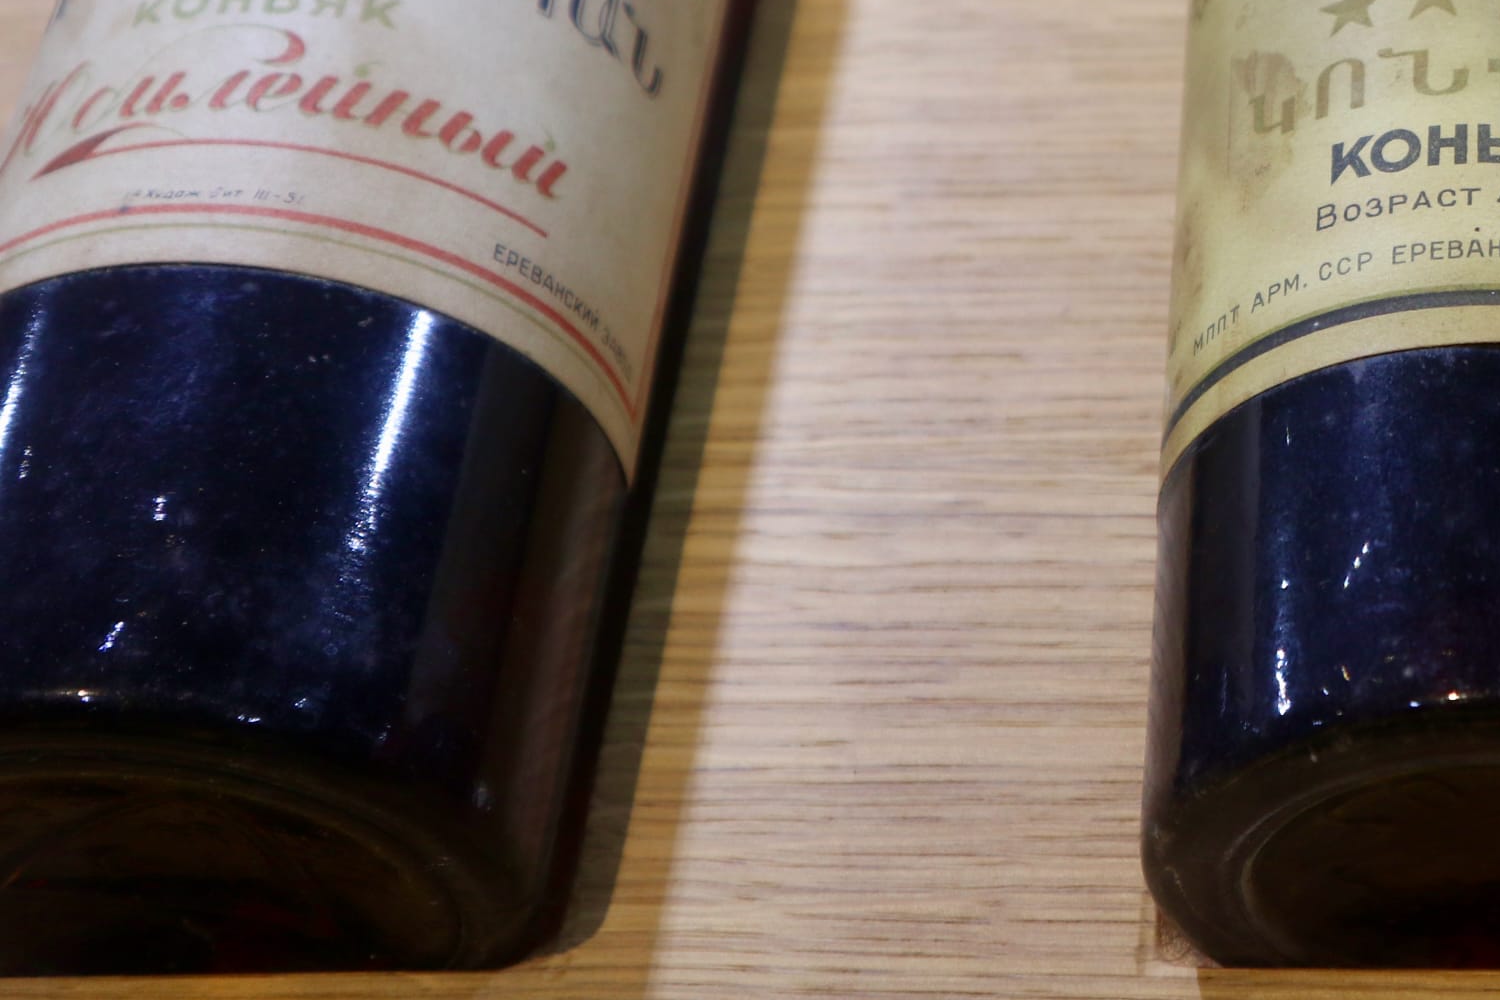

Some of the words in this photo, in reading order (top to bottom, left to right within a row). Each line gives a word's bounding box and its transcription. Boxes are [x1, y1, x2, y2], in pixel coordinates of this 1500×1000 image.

[493, 243, 599, 332] ЕРЕВАНСКИЙ
[1193, 305, 1240, 356] МППТ
[1250, 273, 1307, 313] АРМ.
[1318, 251, 1373, 281] ССР
